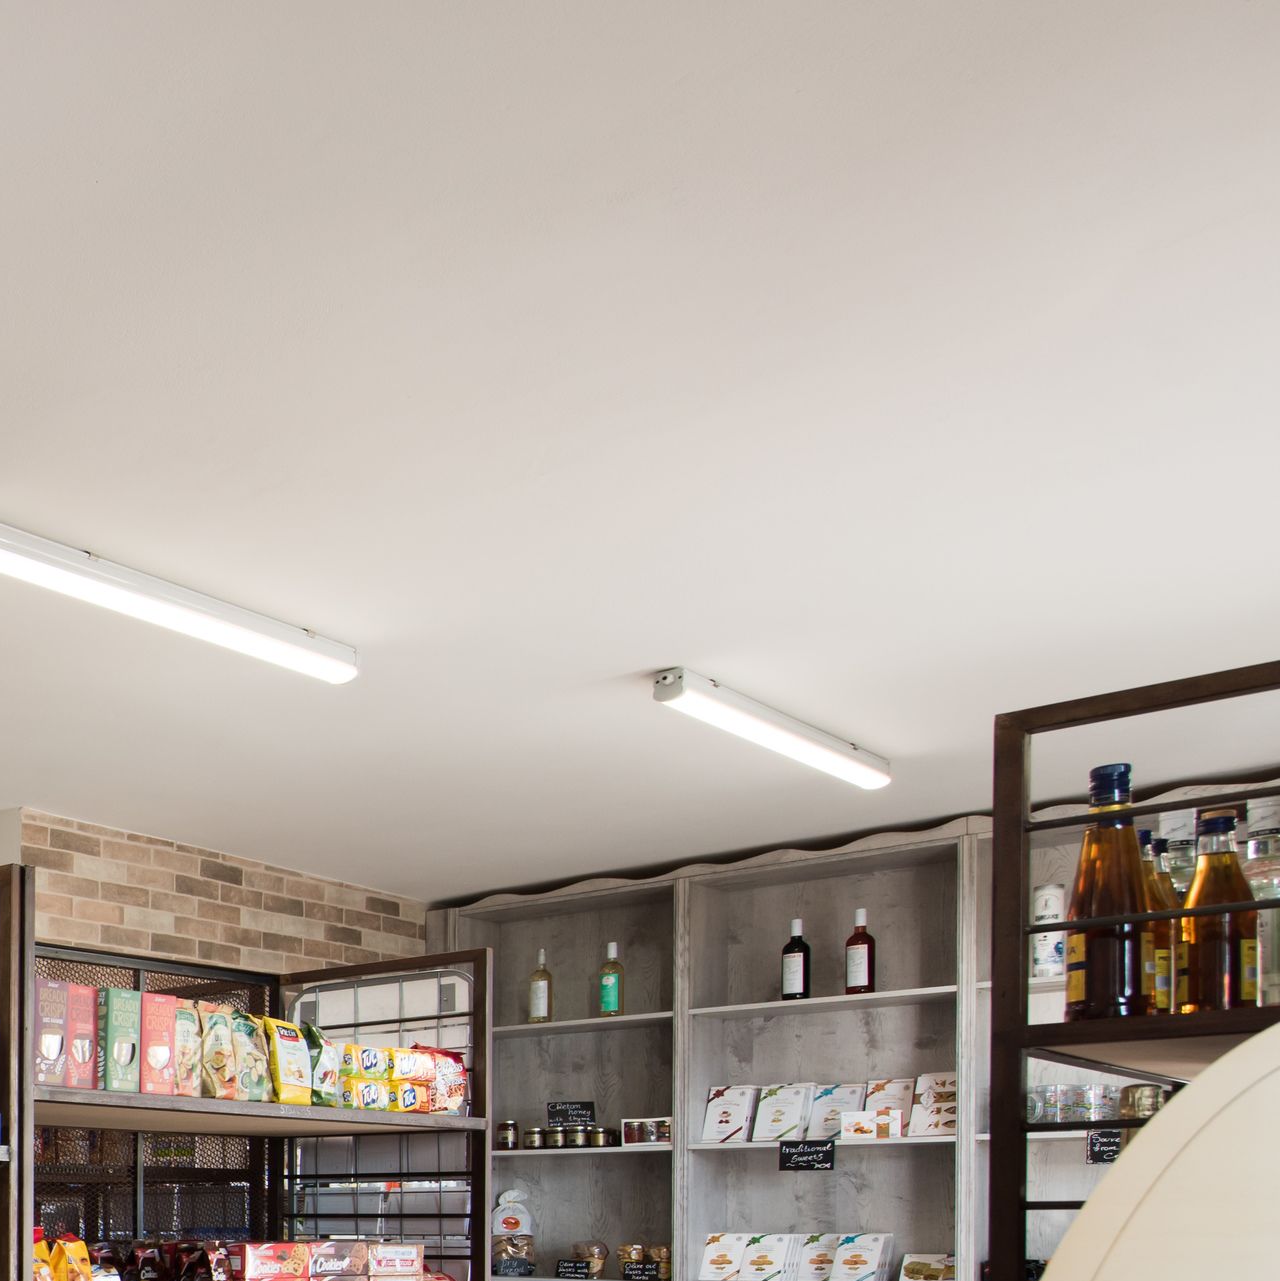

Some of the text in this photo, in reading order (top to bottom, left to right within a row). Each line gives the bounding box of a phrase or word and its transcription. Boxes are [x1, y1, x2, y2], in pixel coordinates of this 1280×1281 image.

[403, 1089, 416, 1106] TUC
[568, 1108, 591, 1117] honey
[782, 1142, 833, 1154] traditional
[317, 1257, 348, 1272] Cookies
[502, 1258, 518, 1269] Dry
